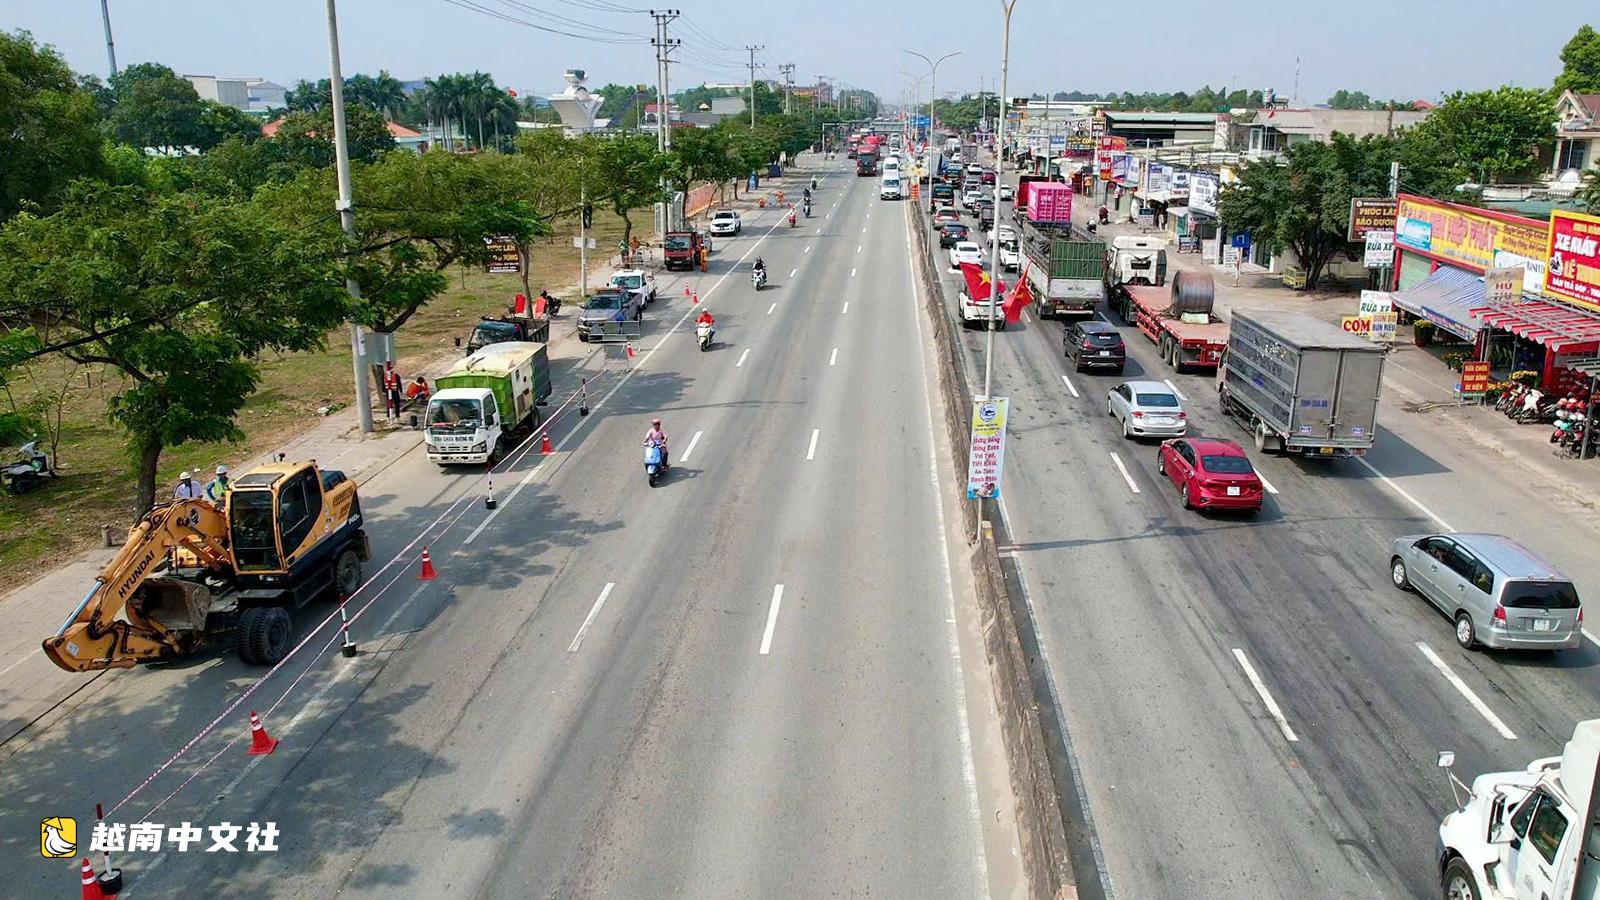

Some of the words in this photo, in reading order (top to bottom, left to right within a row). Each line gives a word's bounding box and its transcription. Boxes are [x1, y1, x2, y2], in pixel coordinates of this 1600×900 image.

[1367, 240, 1382, 250] RỬA
[1382, 242, 1393, 251] XE
[1554, 232, 1571, 250] XE
[1570, 236, 1598, 258] MÁY
[1361, 300, 1377, 312] RỬA
[118, 550, 156, 598] HYUNDAI
